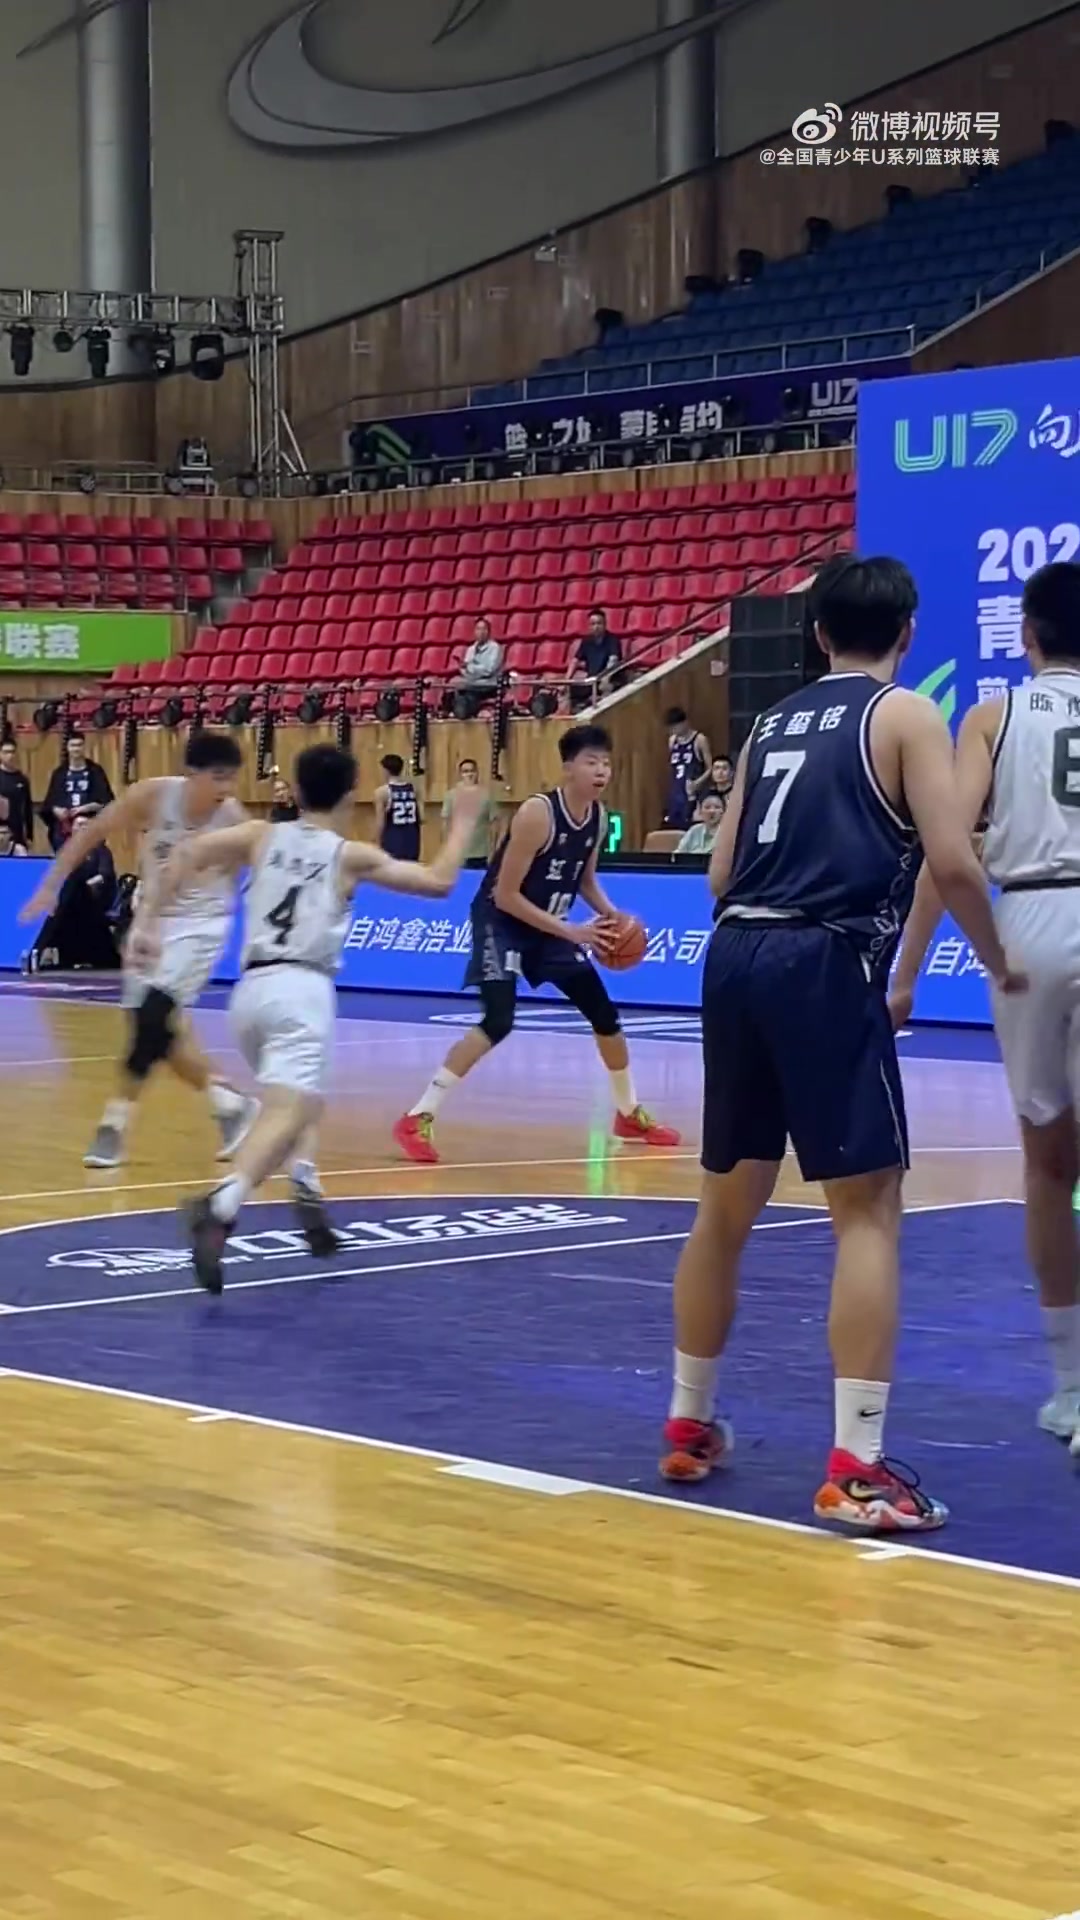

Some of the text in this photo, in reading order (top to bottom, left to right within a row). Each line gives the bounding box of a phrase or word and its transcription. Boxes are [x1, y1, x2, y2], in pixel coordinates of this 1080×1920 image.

[811, 378, 857, 407] U17
[894, 408, 1018, 472] U17
[392, 801, 417, 825] 23
[757, 750, 807, 844] 7
[263, 884, 303, 946] 4
[642, 927, 712, 966] 公司
